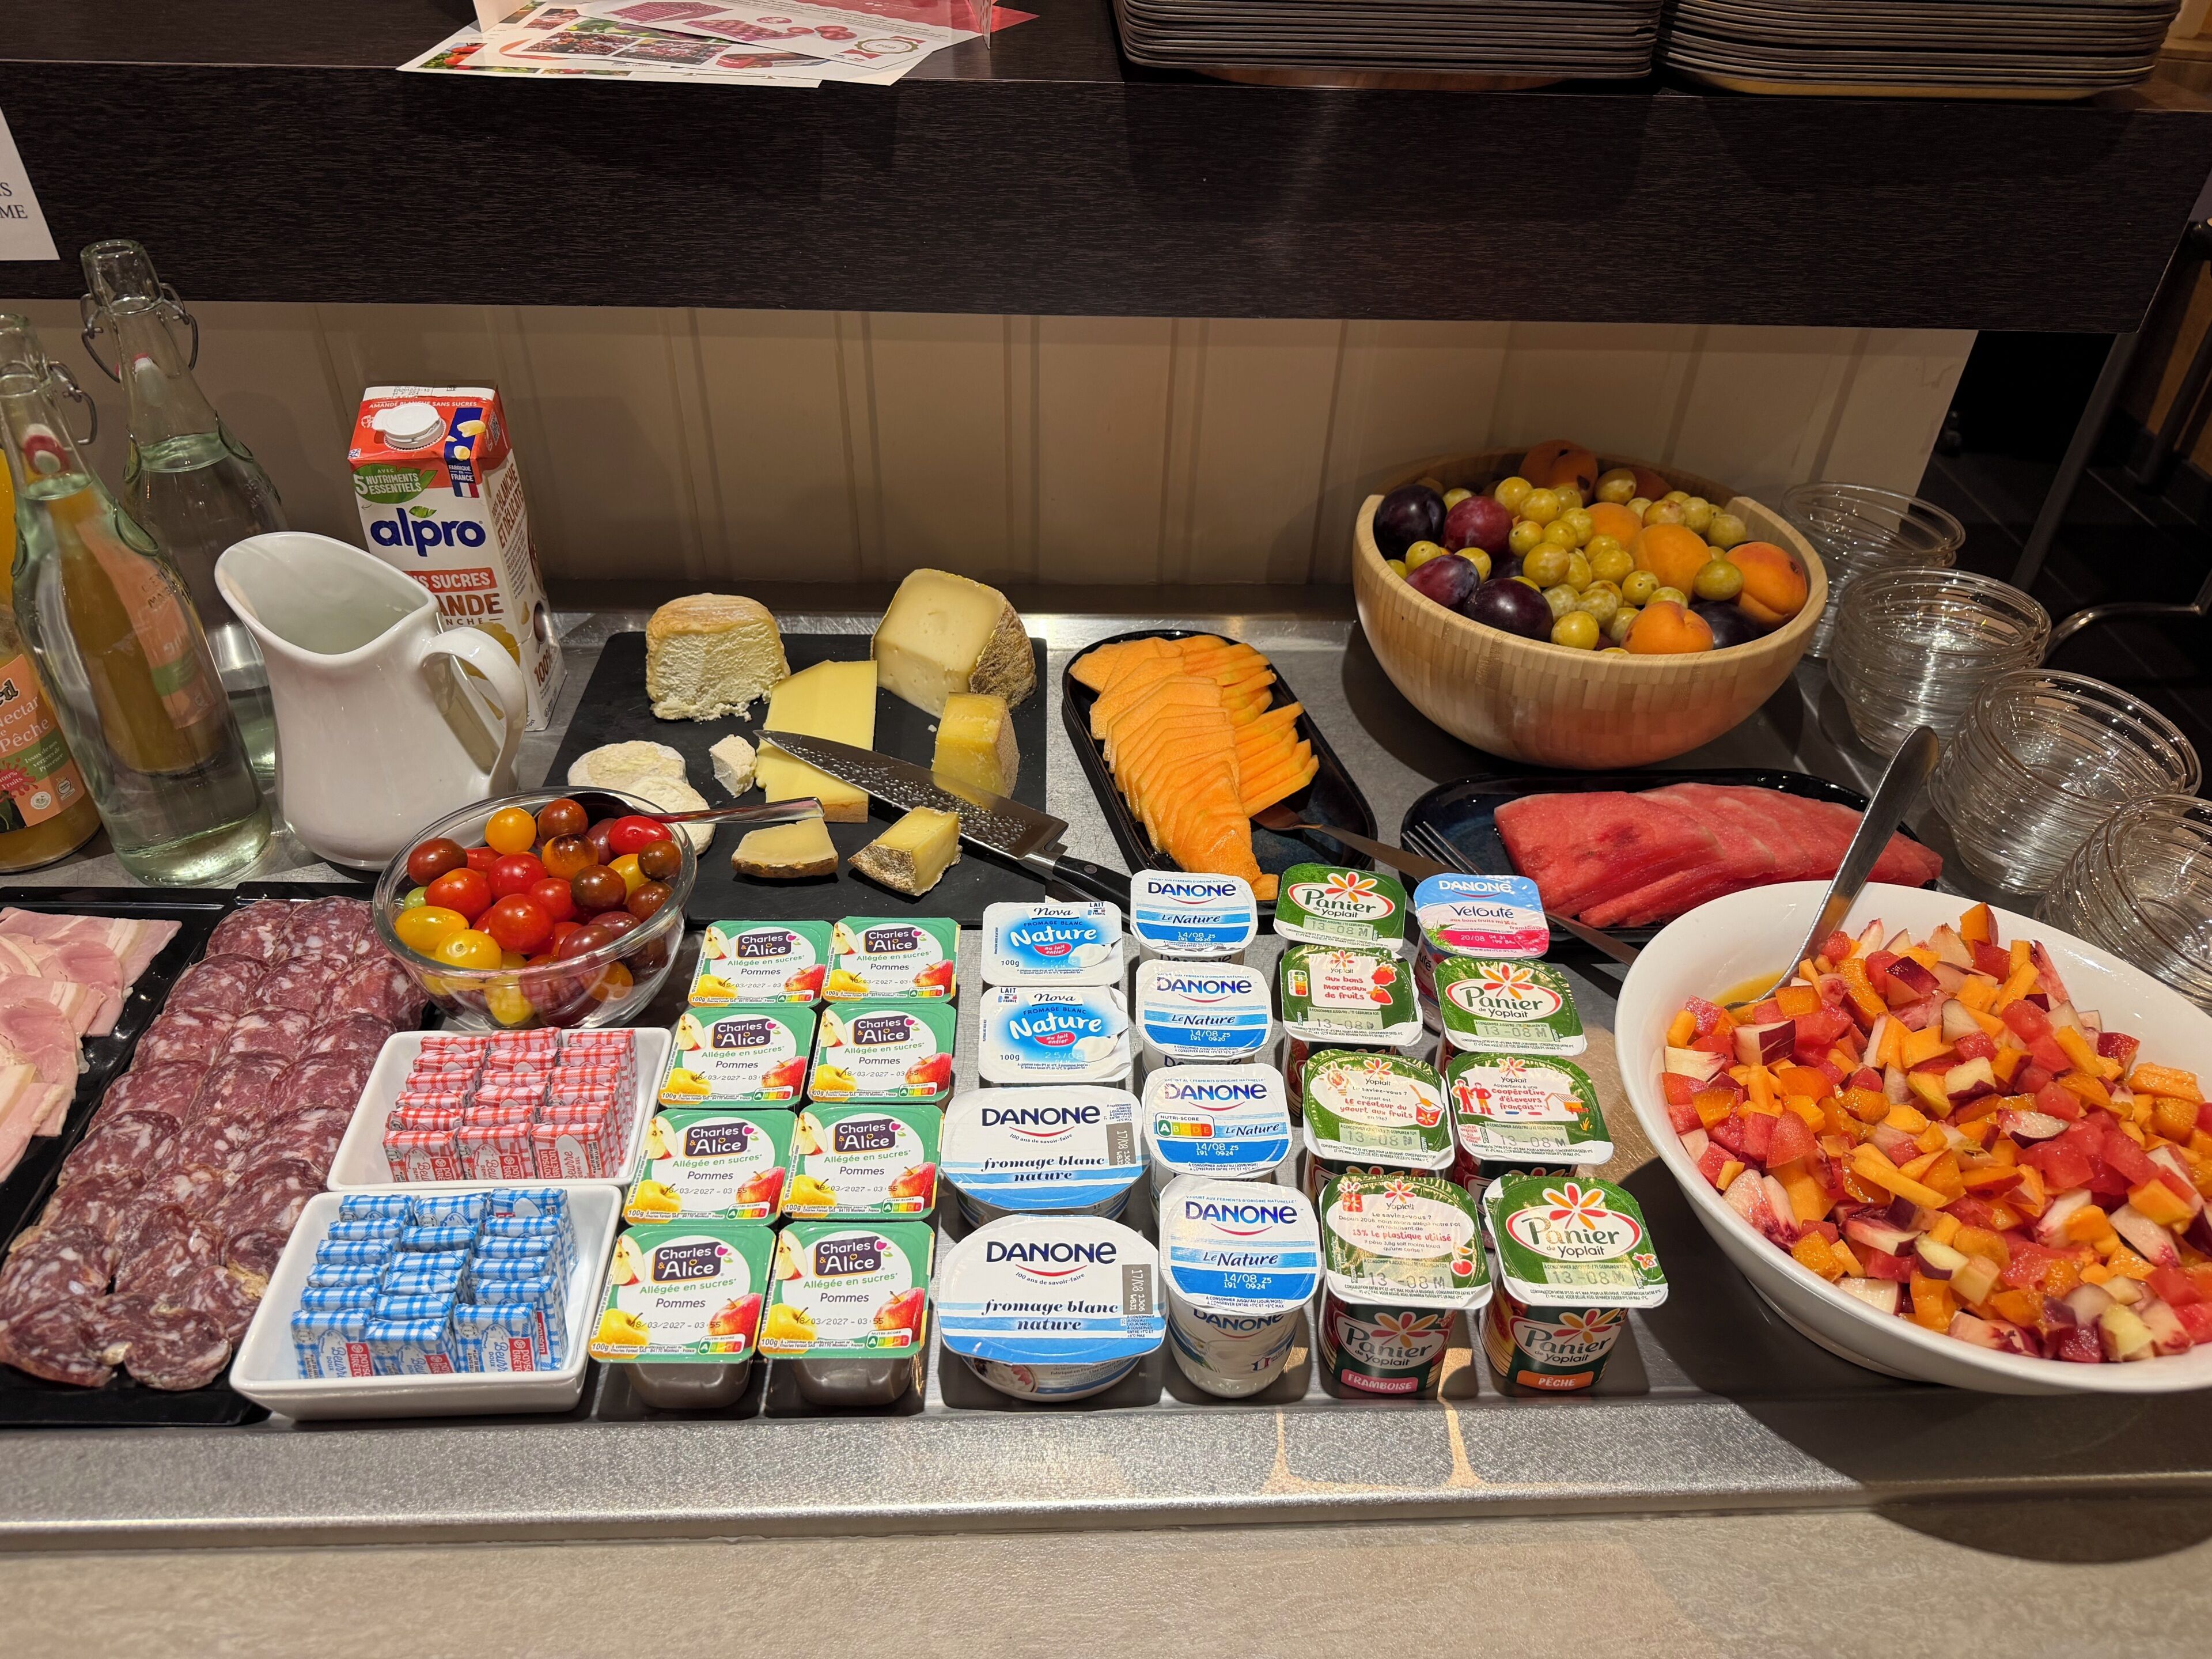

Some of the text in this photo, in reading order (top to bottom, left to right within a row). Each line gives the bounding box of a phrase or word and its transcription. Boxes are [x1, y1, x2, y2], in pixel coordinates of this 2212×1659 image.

[0, 182, 12, 196] S
[353, 474, 368, 495] 5
[365, 473, 419, 484] NUTRIMENTS
[451, 474, 474, 482] FRANCE
[369, 482, 422, 495] ESSENTIELS
[497, 463, 518, 510] BLANCHE
[370, 507, 486, 557] alpro
[431, 572, 490, 589] SUCRES
[435, 593, 504, 616] NDE
[0, 719, 50, 753] Pêche
[1148, 882, 1236, 897] DANONE
[1438, 880, 1512, 893] DANONE
[1302, 889, 1376, 913] Panier
[1034, 907, 1073, 916] Nova
[1322, 909, 1358, 918] Yoplait
[1449, 904, 1514, 918] Velouté
[1173, 915, 1221, 924] Nature
[742, 934, 783, 943] Charles
[869, 930, 909, 939] Charles
[1010, 926, 1097, 947] Nature
[744, 943, 786, 956] Alice
[873, 938, 912, 951] Alice
[1157, 977, 1252, 994] DANONE
[1034, 994, 1076, 1002] Nova
[1339, 992, 1365, 1000] fruits
[1460, 986, 1543, 1010] Panier
[1024, 1007, 1059, 1016] FROMAGE
[1489, 1008, 1528, 1018] Yoplait
[858, 1020, 901, 1029] Charles
[1010, 1012, 1102, 1039] Nature
[1184, 1016, 1235, 1025] Nature
[718, 1023, 762, 1032] Charles
[721, 1032, 765, 1047] Alice
[862, 1028, 904, 1043] Alice
[1165, 1083, 1267, 1100] DANONE
[1357, 1100, 1394, 1109] créateur
[982, 1105, 1100, 1126] DANONE
[1340, 1106, 1369, 1115] yaourt
[1389, 1110, 1412, 1118] fruits
[691, 1127, 738, 1138] Charles
[839, 1123, 886, 1134] Charles
[1236, 1124, 1279, 1135] Nature
[693, 1137, 741, 1154] Alice
[843, 1134, 889, 1150] Alice
[1196, 1143, 1225, 1151] 14/08
[839, 1166, 885, 1175] Pommes
[981, 1156, 1105, 1172] fromage blanc
[688, 1172, 733, 1180] Pommes
[1014, 1172, 1072, 1181] nature
[1185, 1200, 1297, 1224] DANONE
[1386, 1202, 1415, 1210] Yoplait
[1383, 1231, 1421, 1240] plastique
[1521, 1217, 1620, 1245] Panier
[660, 1247, 711, 1259] Charles
[820, 1242, 870, 1255] Charles
[986, 1241, 1116, 1264] DANONE
[1559, 1245, 1605, 1258] Yoplait
[824, 1254, 874, 1274] Alice
[1203, 1251, 1278, 1267] Le Nature
[662, 1259, 714, 1278] Alice
[1048, 1273, 1085, 1285] savoir-faire
[1224, 1272, 1257, 1283] 14/08
[639, 1285, 679, 1294] Allégée
[804, 1280, 842, 1289] Allégée
[656, 1298, 706, 1308] Pommes
[820, 1293, 869, 1302] Pommes
[982, 1299, 1118, 1316] fromage blanc
[1017, 1317, 1082, 1330] nature
[762, 1339, 778, 1347] 100g
[1344, 1321, 1432, 1358] Panier
[1524, 1325, 1611, 1354] Panier
[1364, 1355, 1410, 1366] Yoplait
[1544, 1354, 1589, 1364] Yoplait
[1347, 1373, 1412, 1391] FRAMBOISE
[1539, 1377, 1575, 1387] PÊCHE
